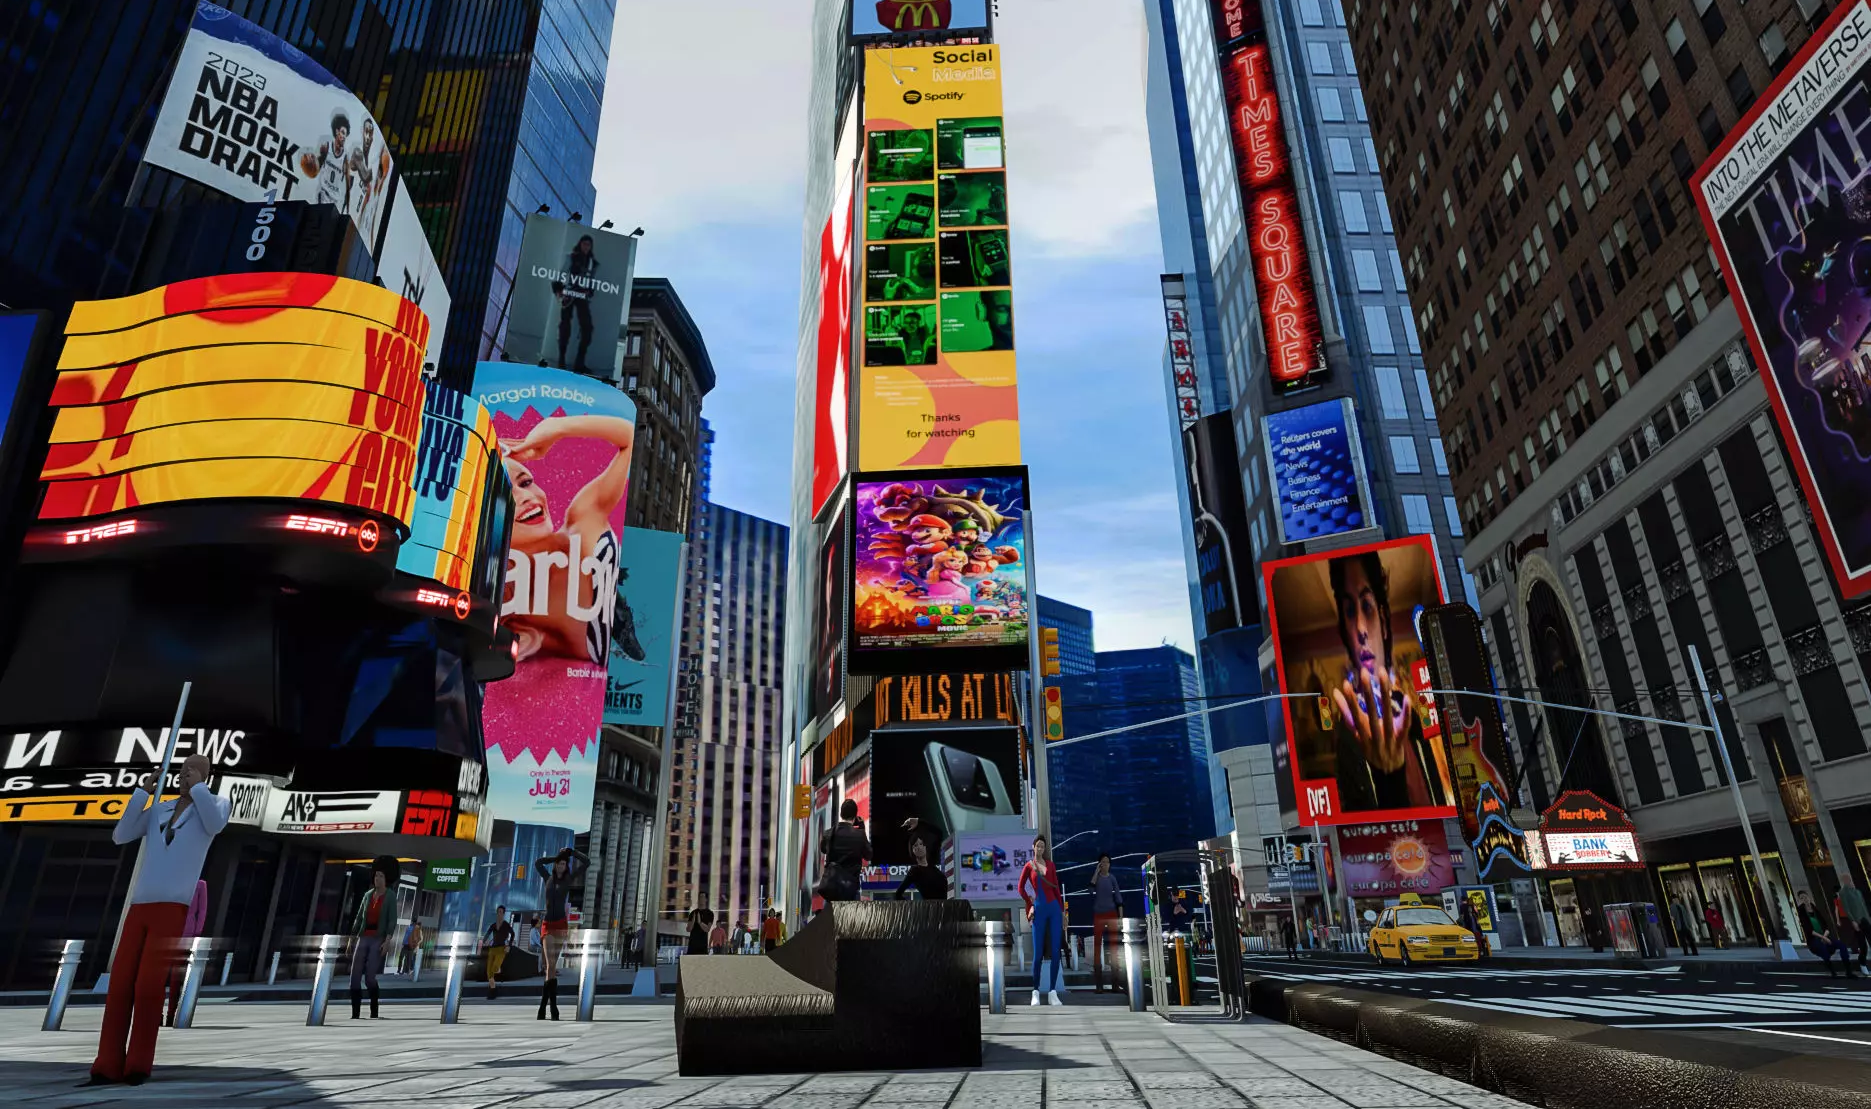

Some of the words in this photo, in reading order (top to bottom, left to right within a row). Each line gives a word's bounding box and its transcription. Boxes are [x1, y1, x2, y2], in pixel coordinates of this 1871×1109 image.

[933, 49, 993, 64] Social
[206, 51, 267, 91] 2023
[197, 64, 278, 129] NBA
[925, 92, 964, 101] Spotify
[1706, 158, 1740, 203] INTO
[1738, 122, 1772, 166] THE
[1768, 10, 1871, 135] METAVERSE
[1238, 52, 1274, 178] TIMES
[187, 93, 300, 173] MOCK
[178, 121, 299, 201] DRAFT
[531, 265, 567, 283] LOUIS
[571, 274, 620, 295] VUITTON
[1260, 198, 1304, 374] SQUARE
[540, 385, 596, 407] Robbie
[921, 414, 961, 423] Thanks
[907, 430, 922, 438] for
[925, 428, 976, 440] watching
[1281, 432, 1310, 445] Reuters
[1312, 426, 1337, 438] covers
[1297, 440, 1321, 453] world
[1285, 460, 1308, 471] News
[1288, 473, 1321, 486] Business
[1290, 487, 1321, 499] Finance
[1292, 496, 1349, 512] Entertainment
[285, 514, 349, 537] ESPN
[360, 530, 377, 542] abc
[416, 589, 449, 607] ESPN
[911, 604, 975, 615] MARIO
[937, 625, 969, 633] MOVIE
[684, 657, 699, 727] HOTEL
[961, 674, 985, 720] AT
[529, 778, 557, 798] July
[1558, 808, 1583, 821] Hard
[1584, 808, 1608, 821] Rock
[1573, 838, 1609, 850] BANK
[1576, 850, 1610, 858] ROBBERY
[431, 867, 466, 875] STARBUCKS
[437, 874, 459, 883] COFFEE
